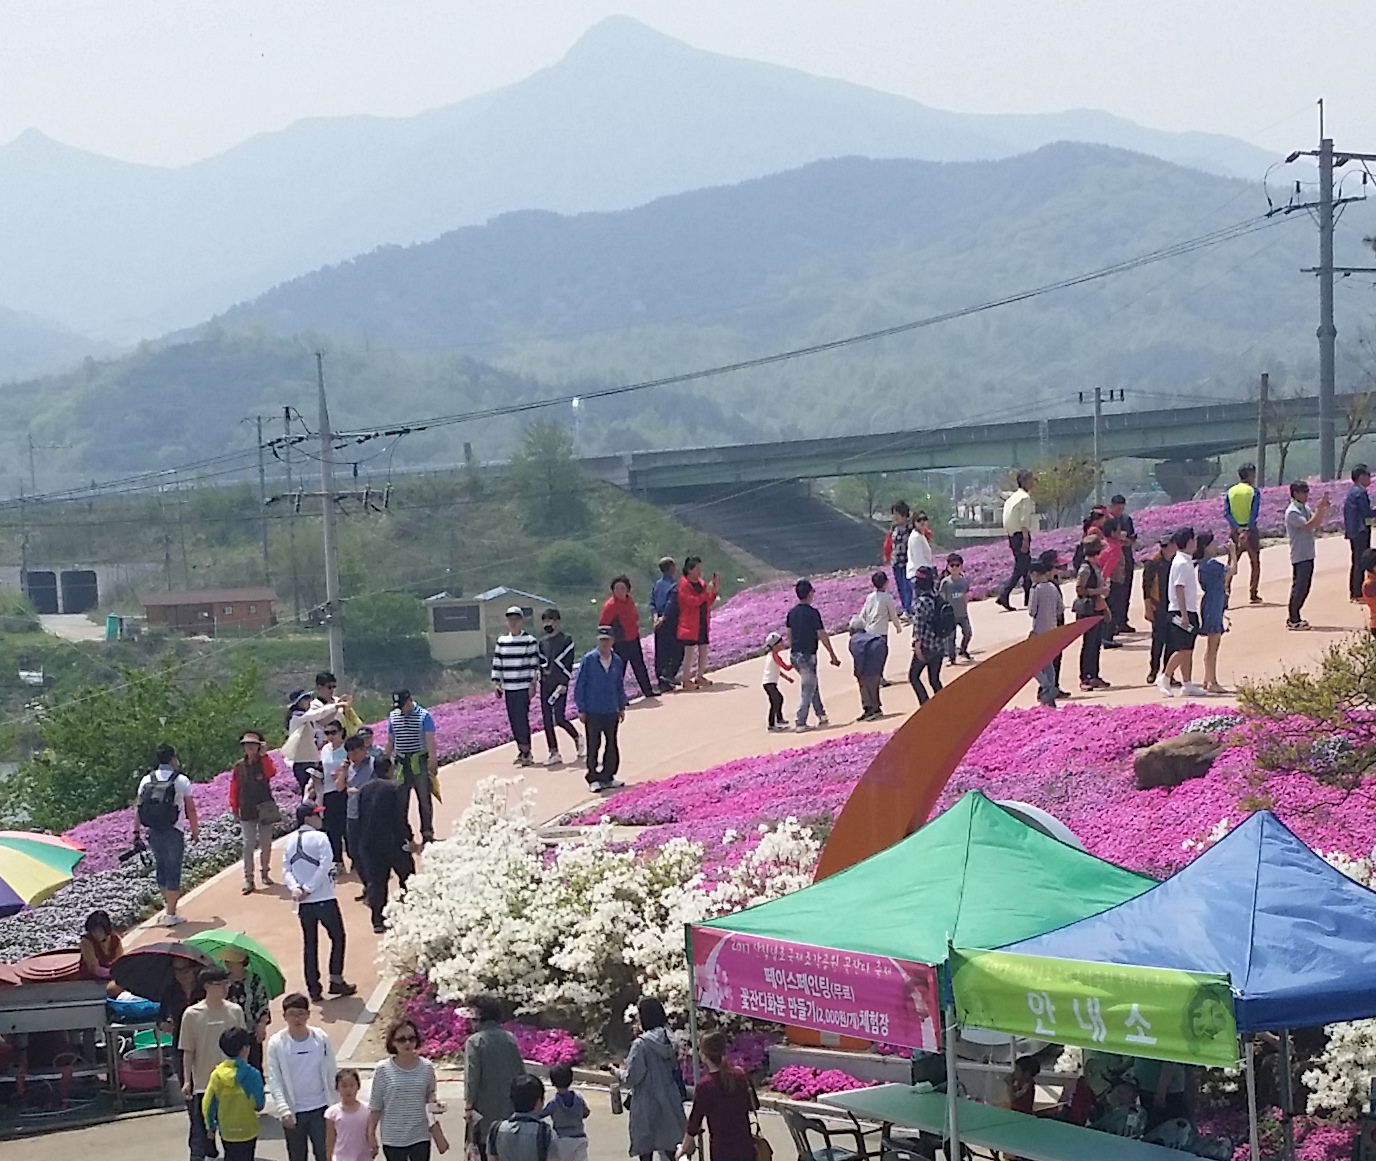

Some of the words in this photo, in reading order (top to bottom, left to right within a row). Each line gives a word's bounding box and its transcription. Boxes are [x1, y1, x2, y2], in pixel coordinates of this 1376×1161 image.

[731, 939, 750, 954] 2017
[764, 967, 855, 1003] 페이스페인팅(무료)
[740, 987, 786, 1017] 꽃잔디화분
